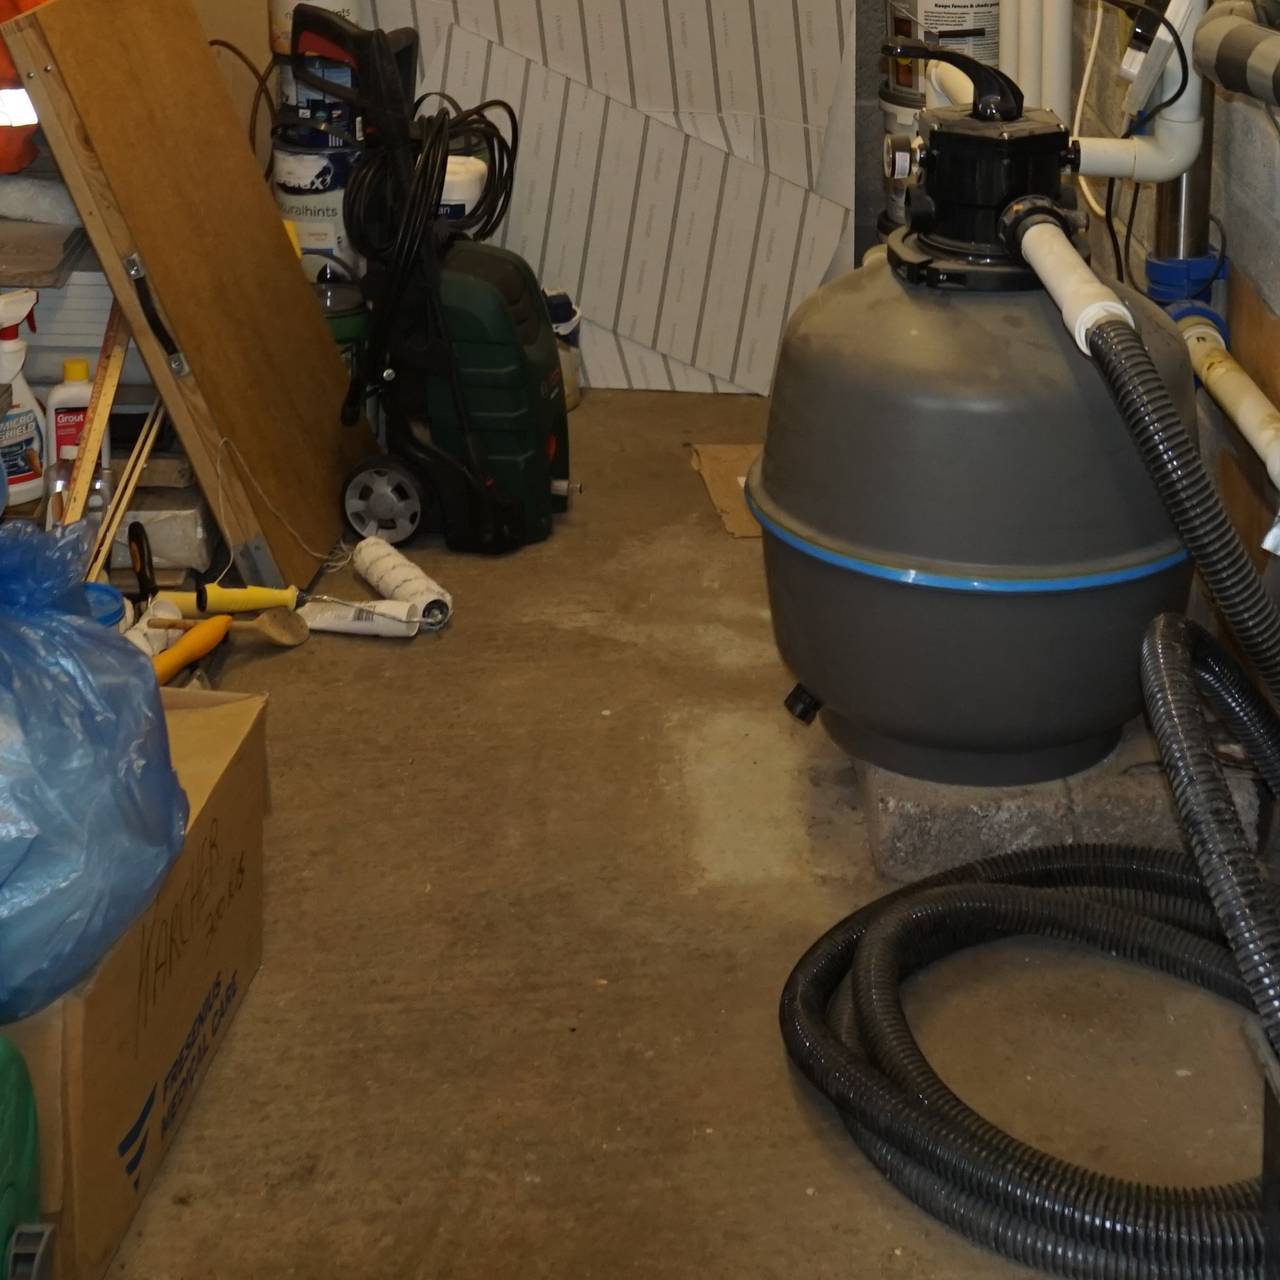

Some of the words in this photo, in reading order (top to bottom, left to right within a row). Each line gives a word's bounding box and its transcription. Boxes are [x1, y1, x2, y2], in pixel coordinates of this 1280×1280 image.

[0, 414, 33, 431] MICRO
[56, 414, 84, 424] Grout
[211, 970, 238, 1037] CARE
[162, 970, 221, 1104] FRESENIUS
